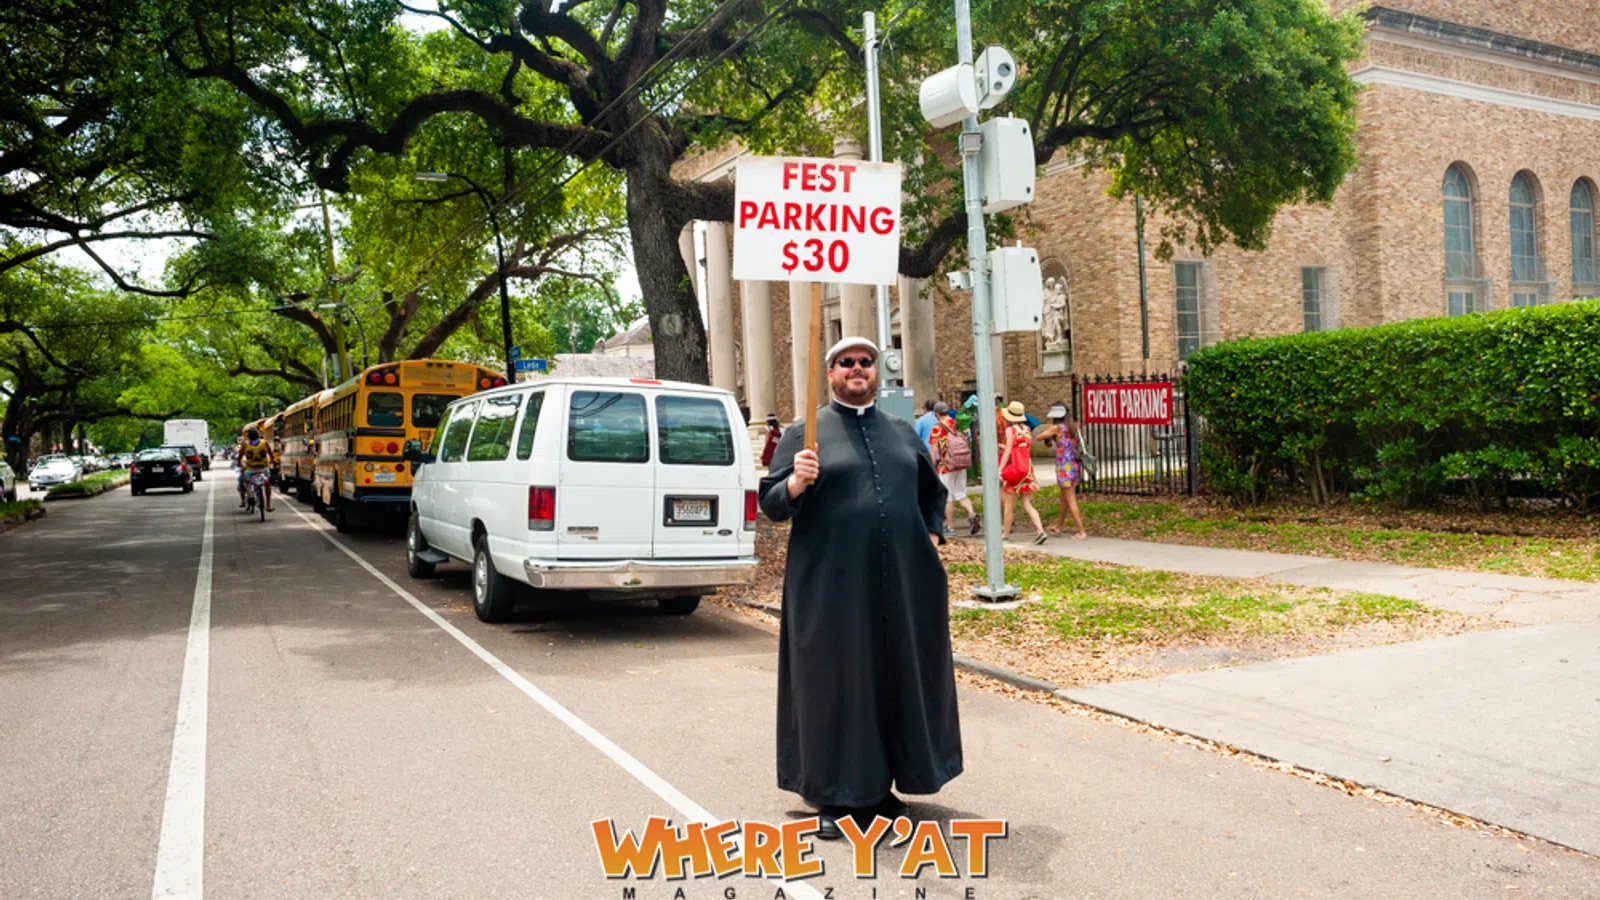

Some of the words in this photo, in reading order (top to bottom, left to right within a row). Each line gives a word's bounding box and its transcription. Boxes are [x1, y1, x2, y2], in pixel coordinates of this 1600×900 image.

[782, 162, 857, 193] FEST
[739, 201, 895, 235] PARKING
[781, 238, 850, 275] $30
[1087, 389, 1118, 418] EVENT
[1120, 388, 1167, 418] PARKING
